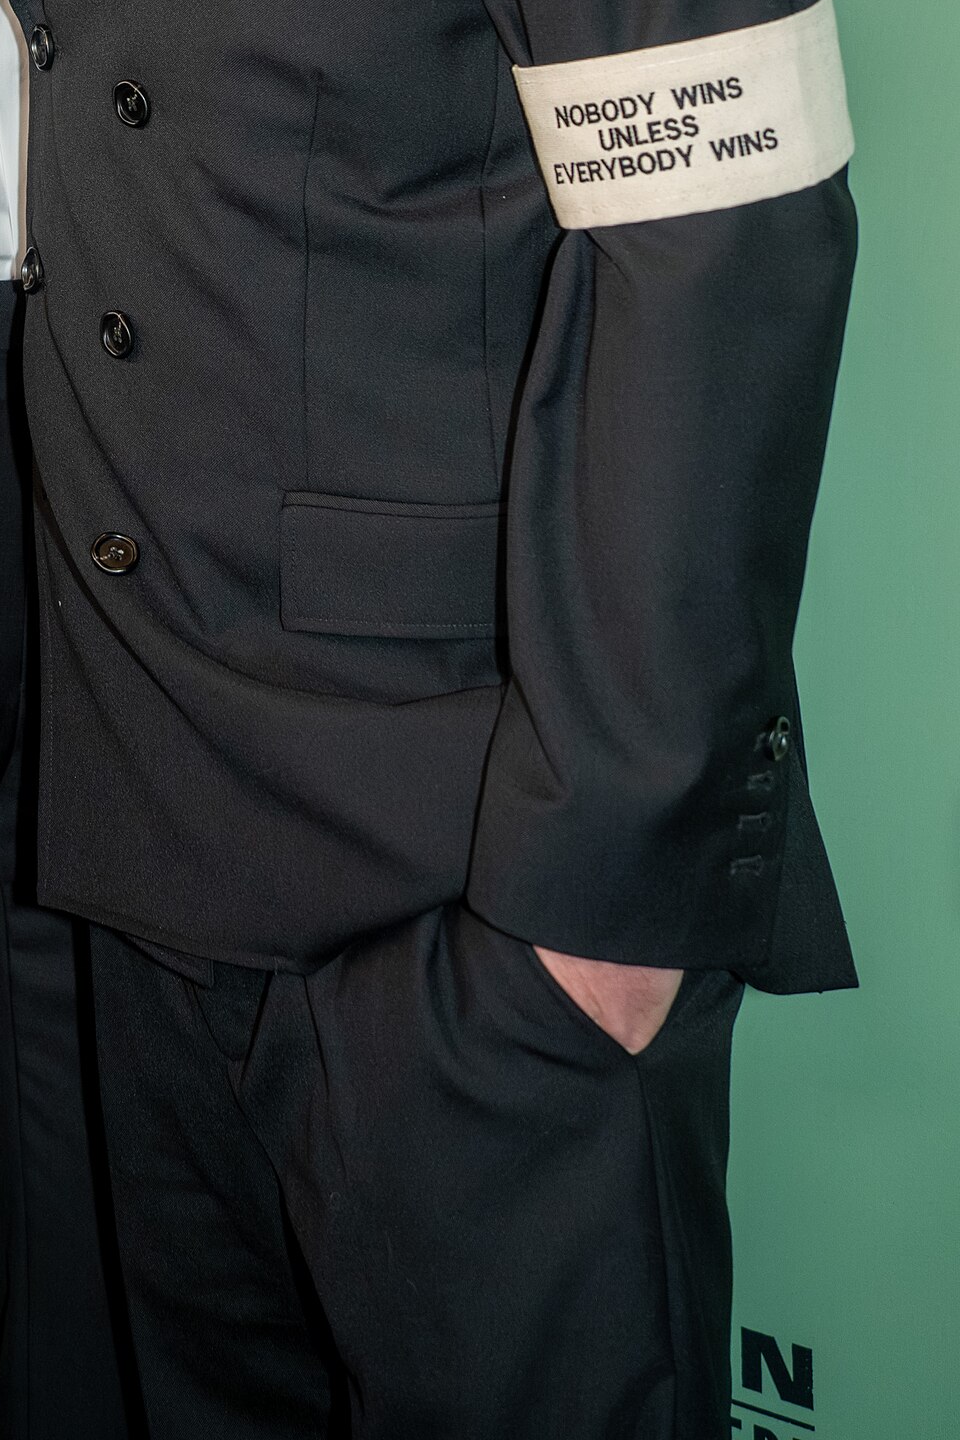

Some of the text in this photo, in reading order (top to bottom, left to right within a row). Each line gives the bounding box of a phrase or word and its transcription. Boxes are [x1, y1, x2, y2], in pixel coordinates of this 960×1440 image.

[554, 76, 743, 129] NOBODY WINS
[553, 128, 779, 186] EVERYBODY WINS
[597, 115, 700, 152] UNLESS
